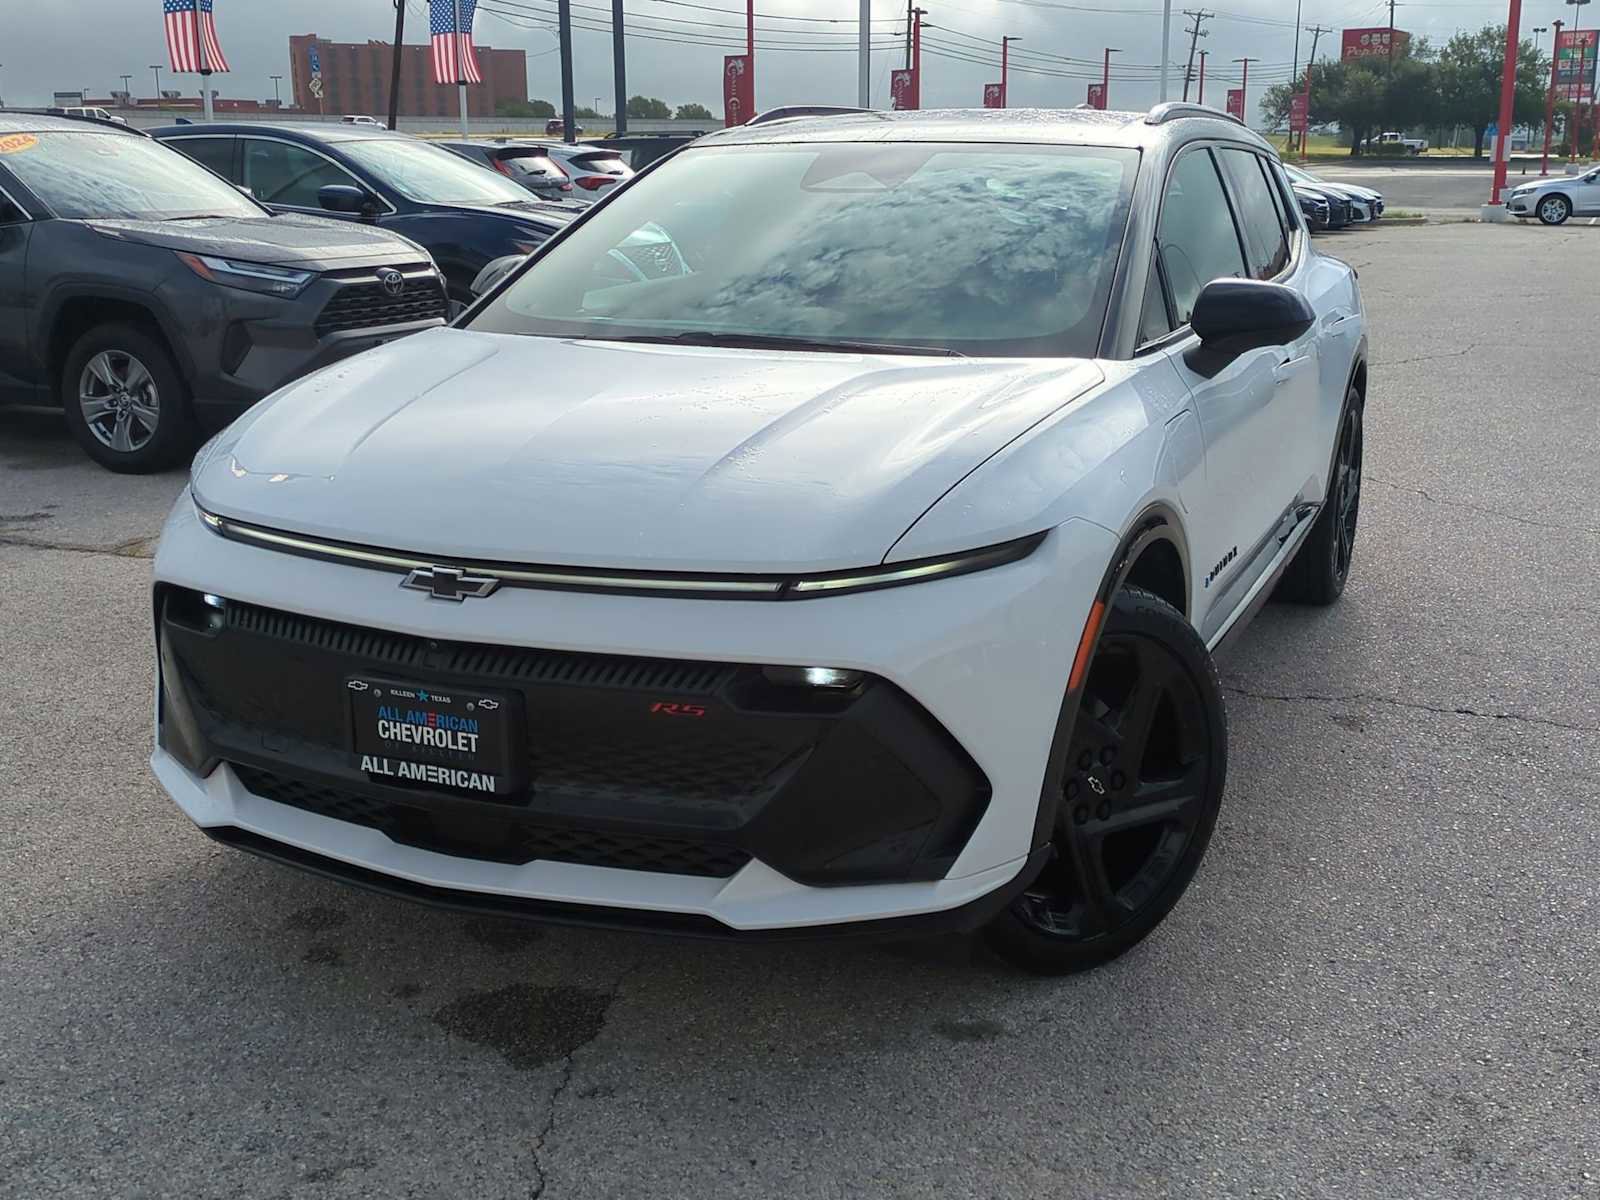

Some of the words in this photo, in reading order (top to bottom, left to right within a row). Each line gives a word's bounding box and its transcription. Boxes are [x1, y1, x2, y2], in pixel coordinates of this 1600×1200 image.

[390, 689, 416, 698] KILLEEN
[430, 694, 452, 704] TEXAS
[651, 702, 705, 717] RS
[377, 705, 404, 721] ALL
[406, 710, 480, 733] AMERICAN
[377, 719, 480, 753] CHEVROLET
[360, 755, 395, 776] ALL
[397, 761, 497, 793] AMERICAN
